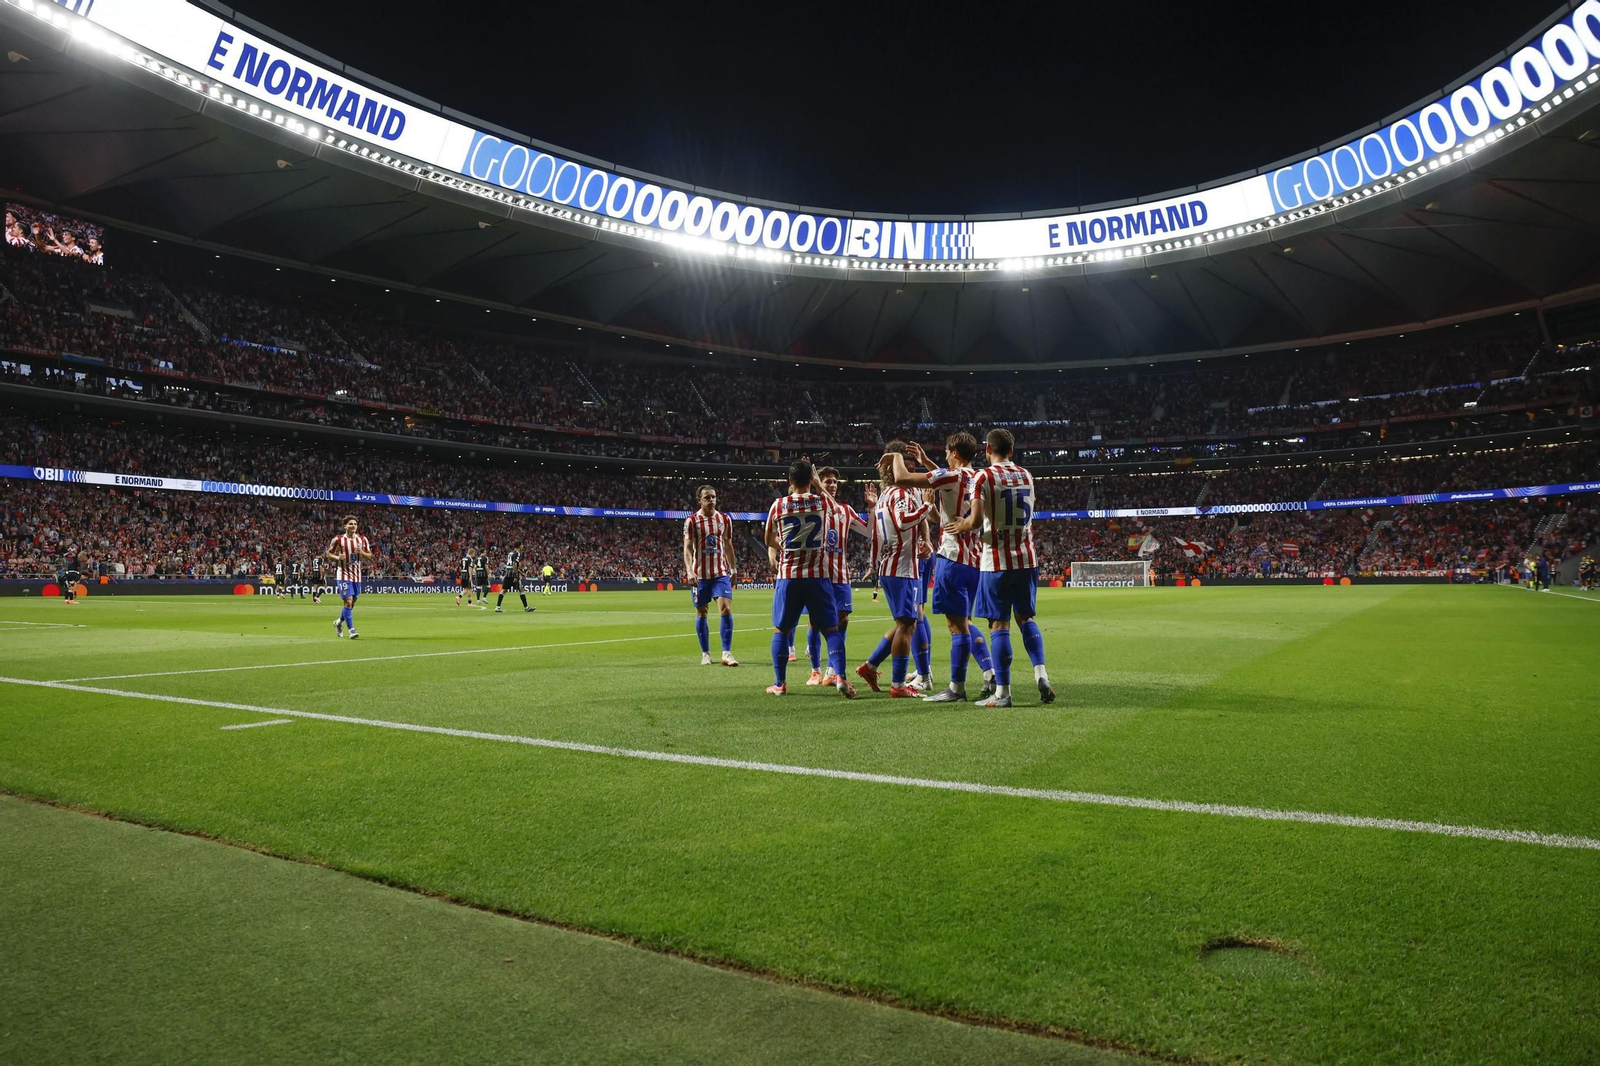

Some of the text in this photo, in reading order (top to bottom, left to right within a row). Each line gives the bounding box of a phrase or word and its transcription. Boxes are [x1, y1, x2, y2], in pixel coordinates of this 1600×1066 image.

[207, 31, 407, 142] E NORMAND
[1049, 200, 1208, 248] E NORMAND
[121, 476, 163, 487] NORMAND
[1001, 489, 1031, 526] 15
[783, 514, 822, 549] 22
[398, 586, 441, 594] CHAMPIONS
[737, 582, 774, 590] mastercard
[1065, 579, 1134, 588] mastercard
